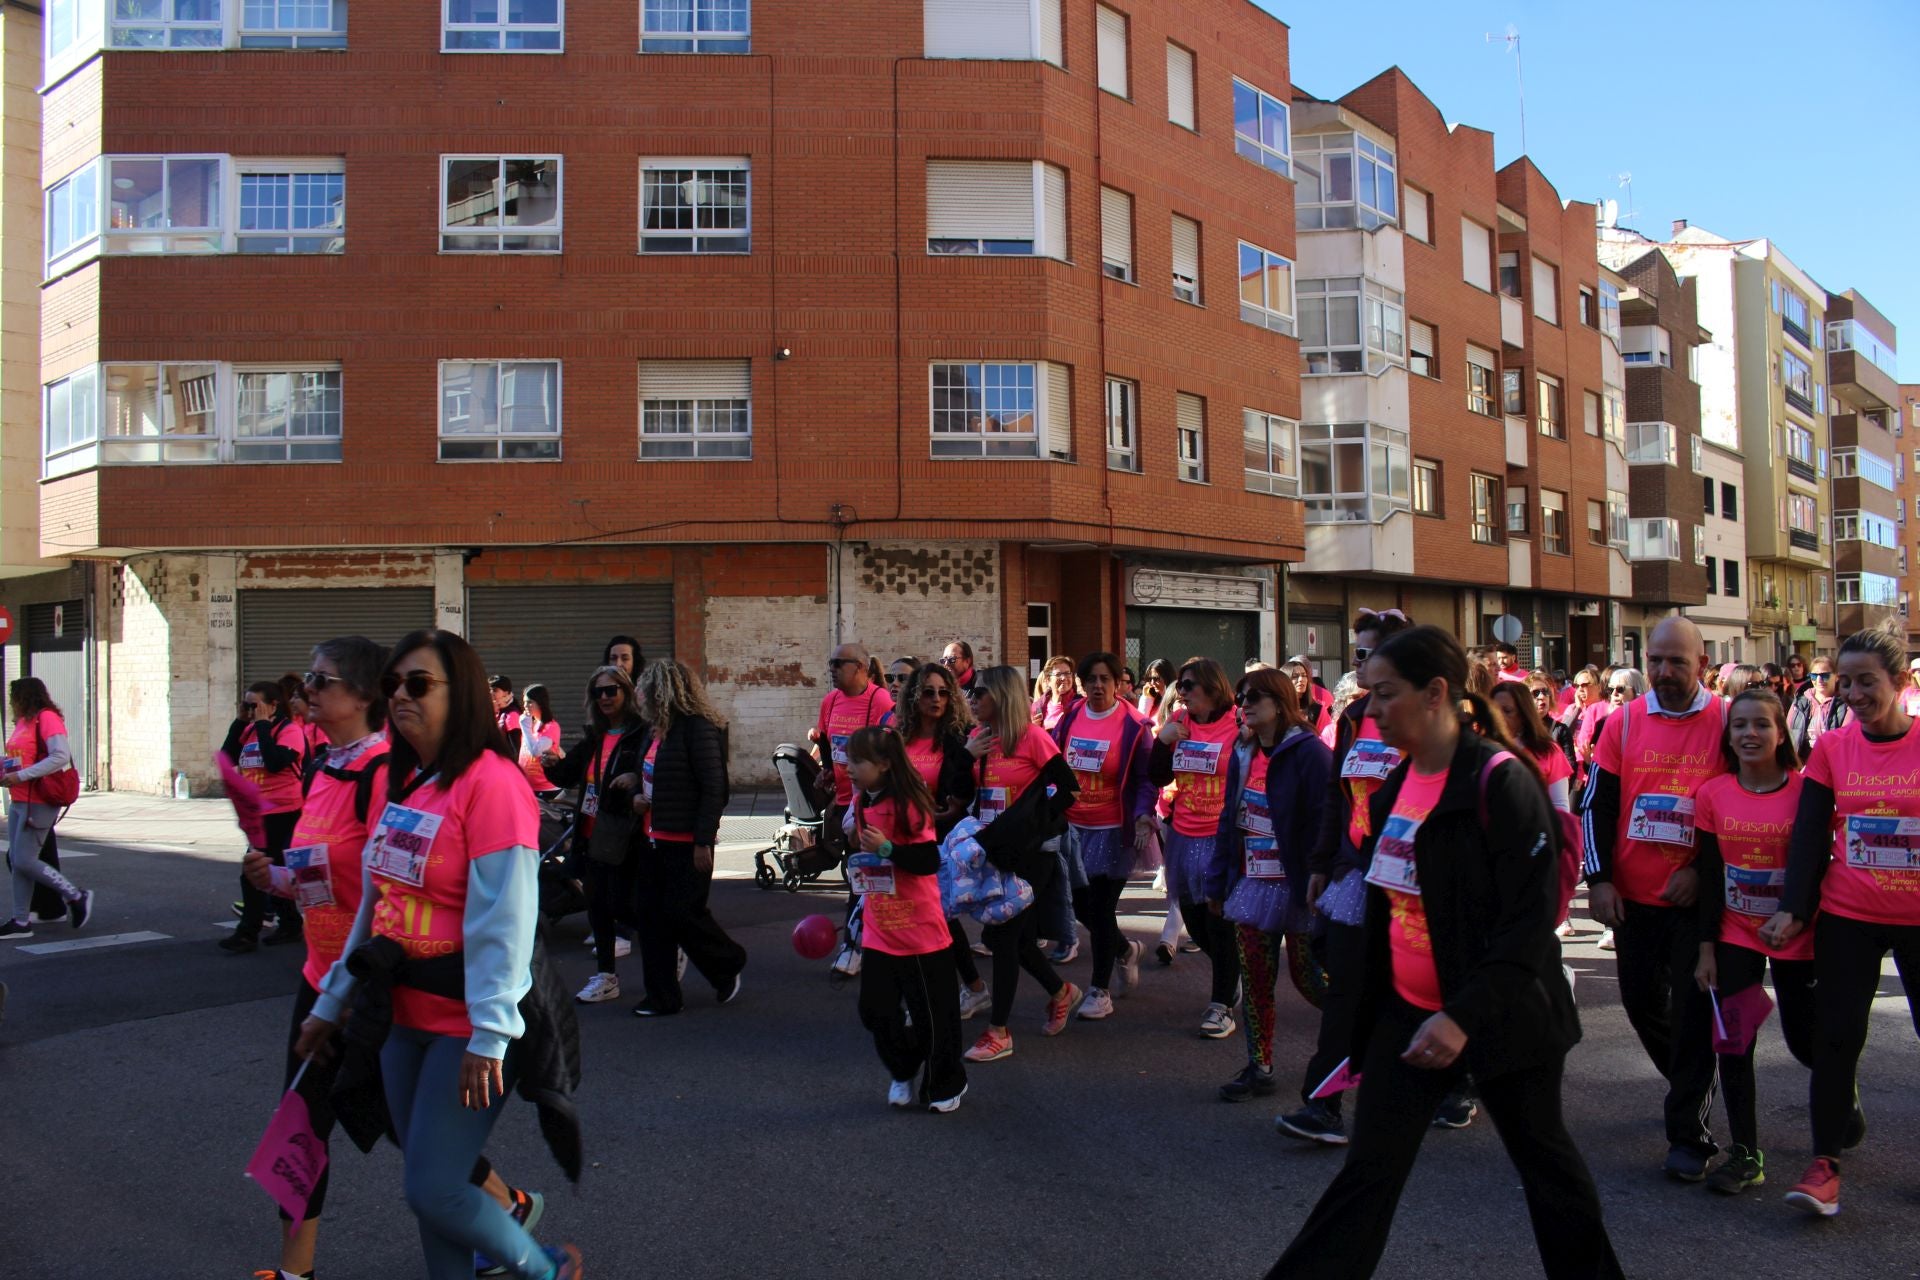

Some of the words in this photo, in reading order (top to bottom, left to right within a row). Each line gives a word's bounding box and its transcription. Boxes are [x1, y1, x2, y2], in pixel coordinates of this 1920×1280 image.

[211, 594, 232, 602] ALQUILA
[1643, 748, 1709, 765] Drasanvi
[1846, 769, 1919, 786] Drasanvi
[1660, 784, 1690, 792] SUZUKI
[1654, 810, 1685, 825] 4144
[1864, 807, 1899, 815] SUZUKI
[1647, 824, 1656, 837] 11
[1723, 816, 1793, 834] Drasanvi
[392, 831, 423, 853] 4830
[1872, 834, 1910, 848] 4143
[1865, 850, 1877, 864] 11
[1748, 884, 1777, 897] 4141
[1742, 897, 1752, 911] 11
